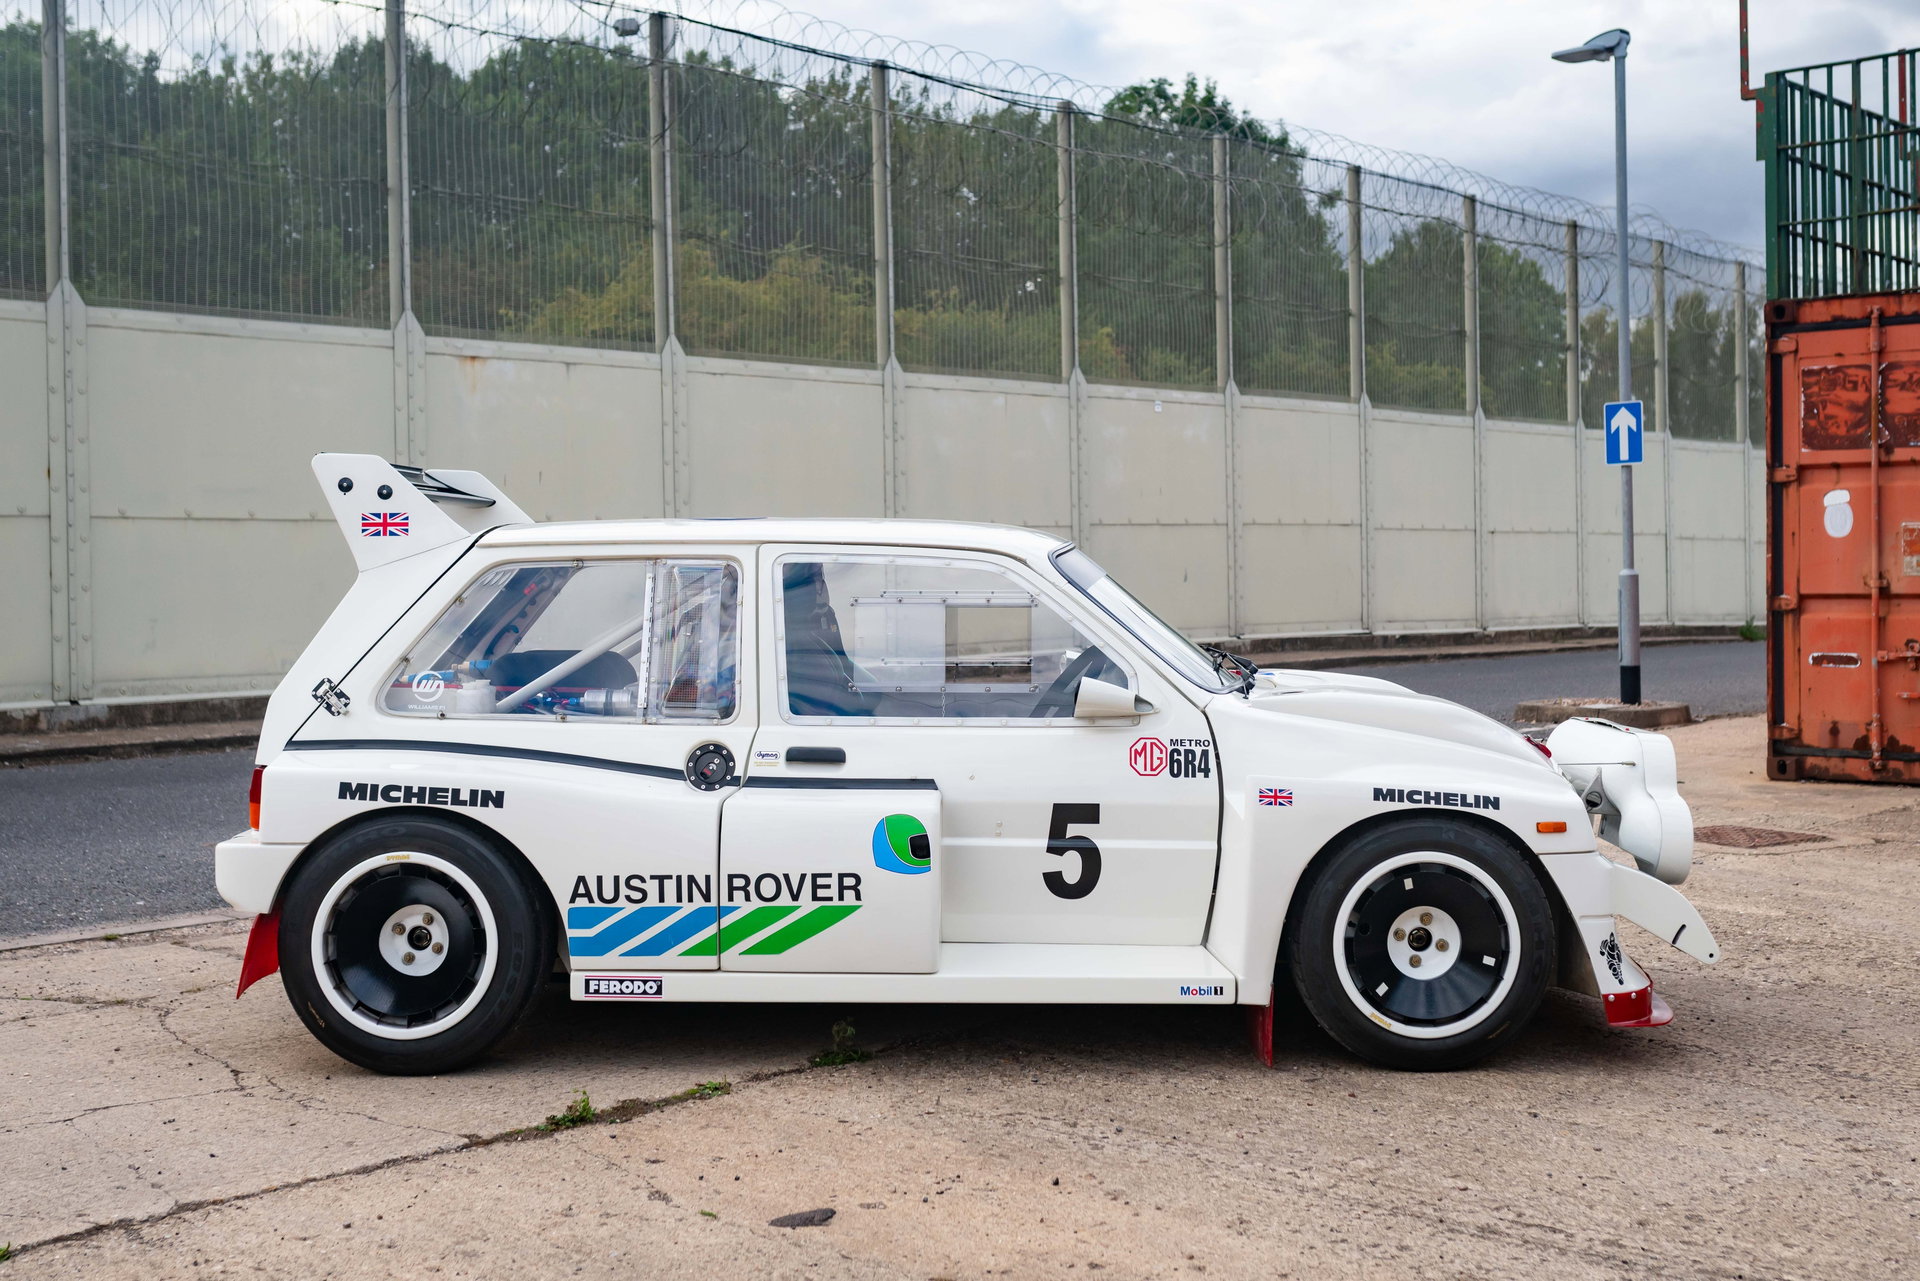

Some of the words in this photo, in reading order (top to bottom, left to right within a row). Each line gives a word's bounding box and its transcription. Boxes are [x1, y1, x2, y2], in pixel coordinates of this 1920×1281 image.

[1133, 740, 1165, 773] MG
[1169, 738, 1212, 748] METRO
[1169, 748, 1211, 779] 6R4
[338, 781, 505, 809] MICHELIN
[1373, 787, 1500, 811] MICHELIN
[1042, 802, 1102, 900] 5
[569, 874, 712, 905] AUSTIN
[727, 872, 863, 903] ROVER
[588, 980, 658, 994] FERODO
[1180, 986, 1212, 996] Mobil
[1214, 985, 1223, 996] 1
